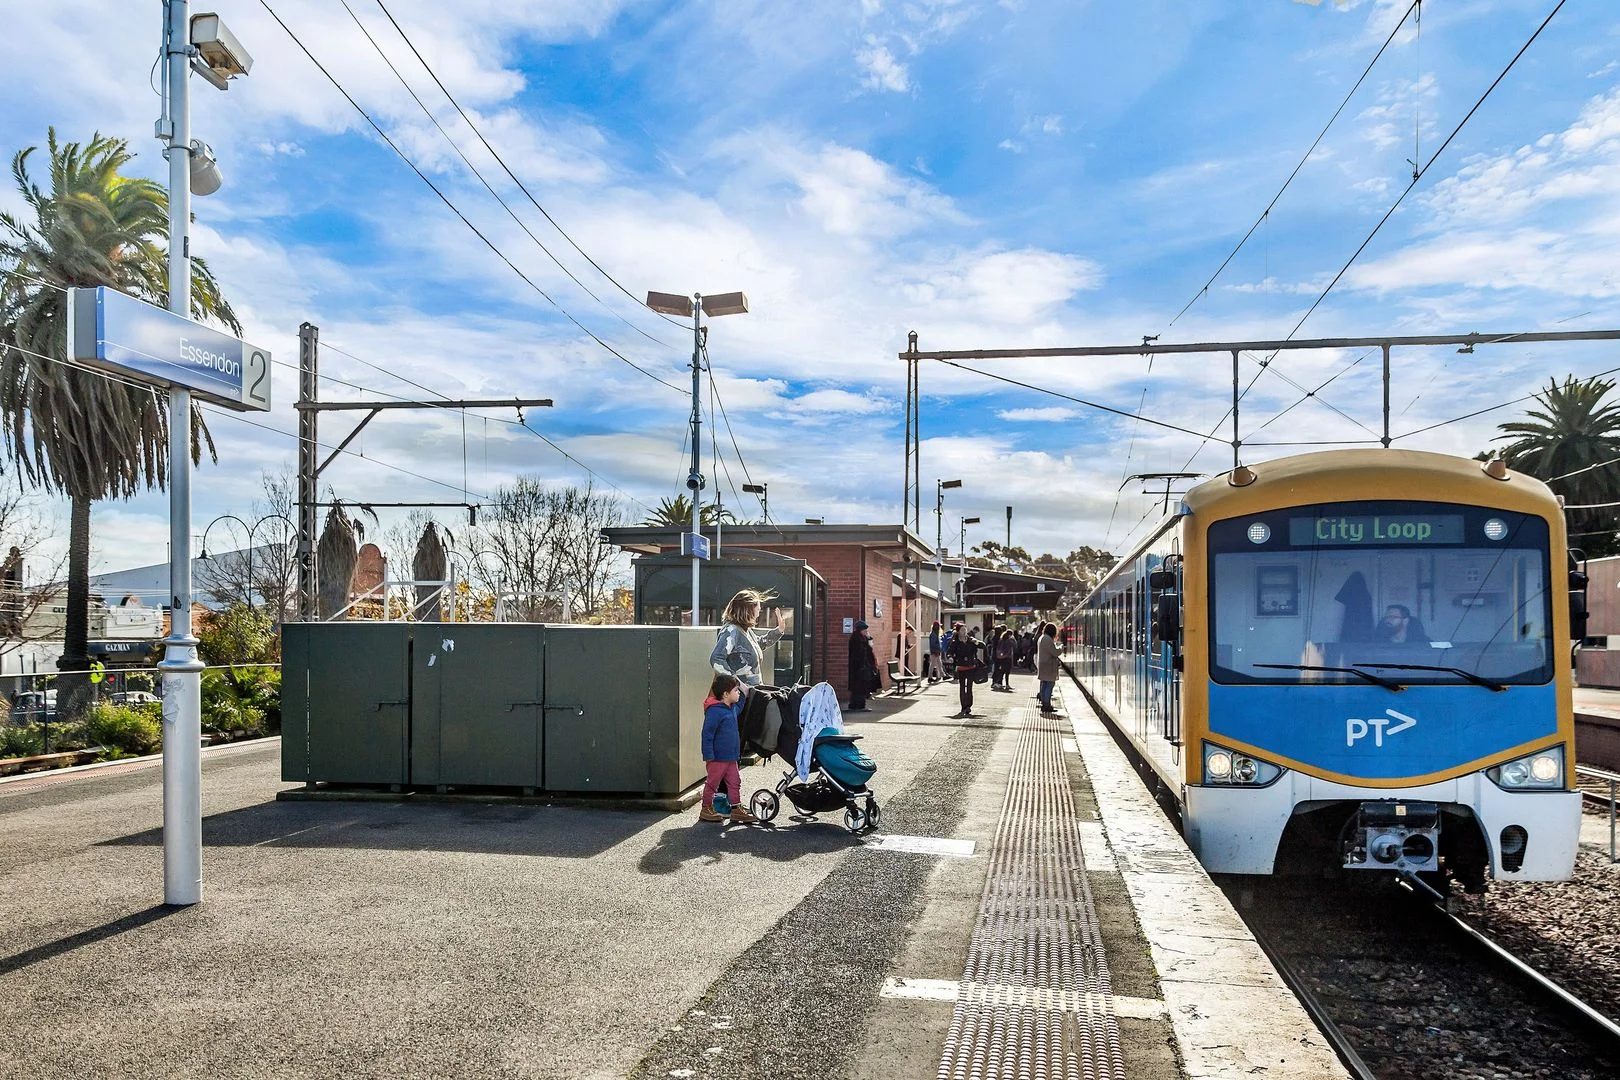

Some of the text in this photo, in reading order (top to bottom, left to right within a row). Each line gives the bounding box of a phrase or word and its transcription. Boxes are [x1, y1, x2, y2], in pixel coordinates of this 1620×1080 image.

[179, 336, 240, 378] Essendon
[249, 350, 266, 403] 2
[1316, 517, 1432, 541] City Loop
[105, 643, 130, 652] GAZMAN
